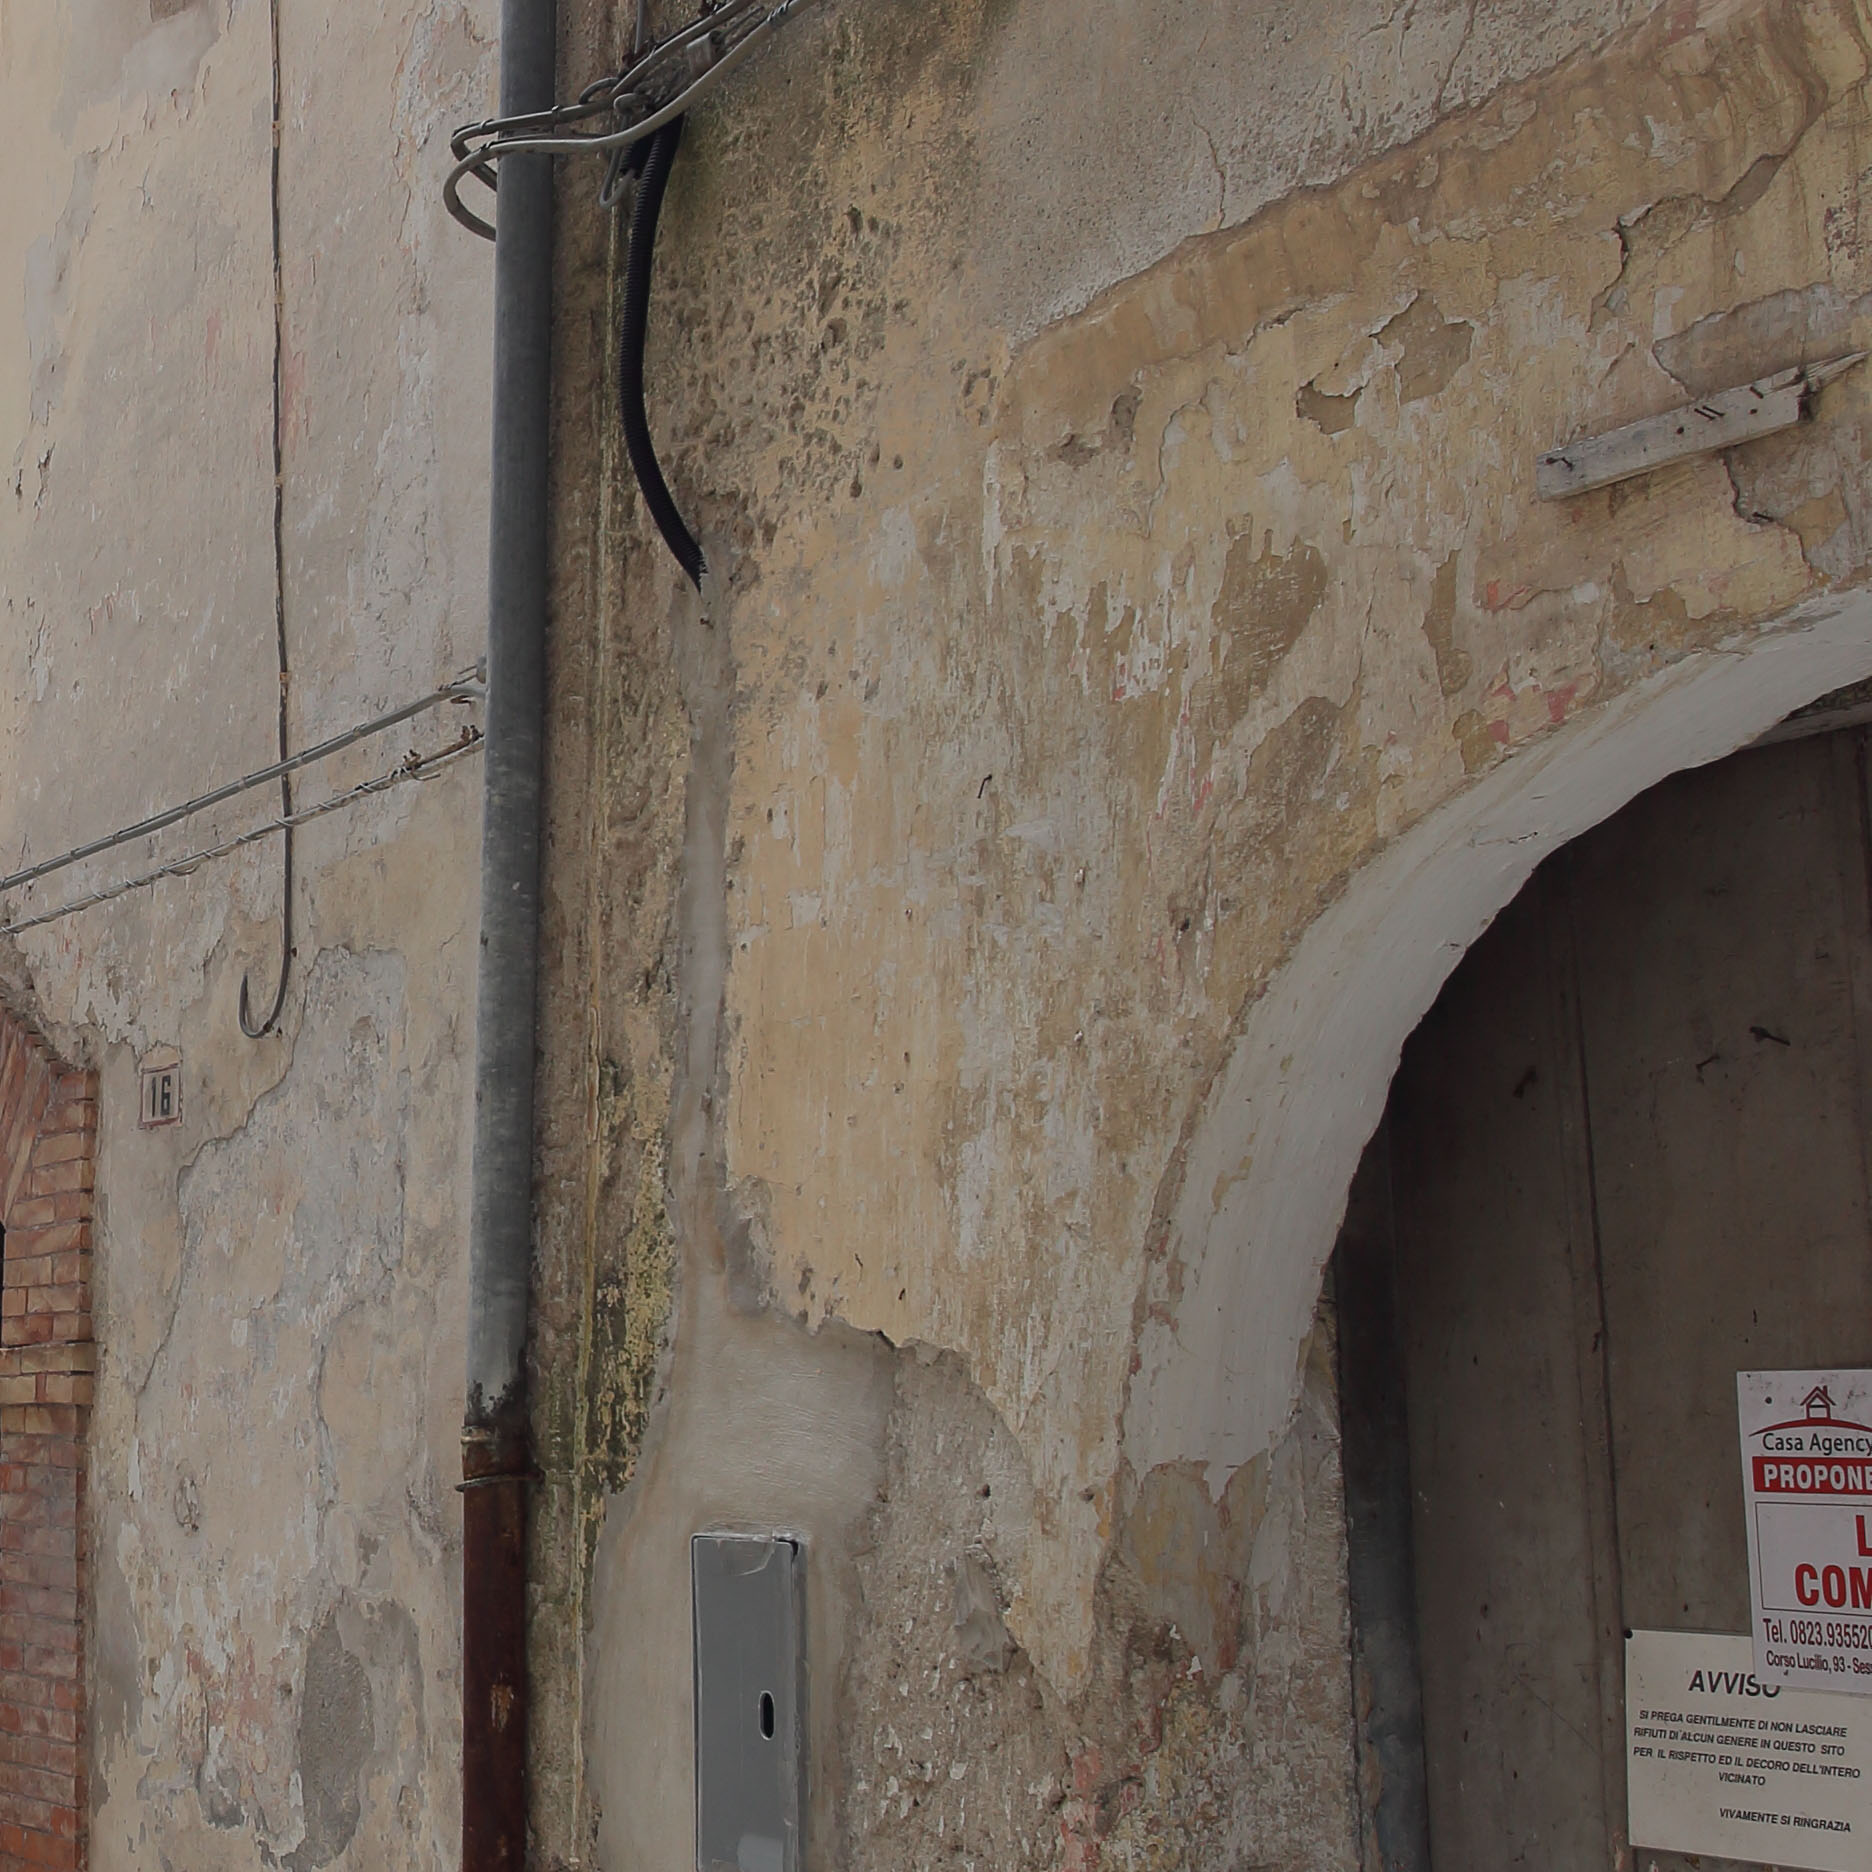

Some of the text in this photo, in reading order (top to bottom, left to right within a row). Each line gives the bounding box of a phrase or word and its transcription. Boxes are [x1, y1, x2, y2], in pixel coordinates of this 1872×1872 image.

[151, 1074, 171, 1117] 16
[1763, 1432, 1872, 1456] Casa Agency
[1762, 1617, 1787, 1643] Tel.
[1766, 1650, 1795, 1668] Corso
[1833, 1655, 1845, 1672] 93
[1639, 1710, 1848, 1737] SI PREGA GENTILMENTE DI NON LASCIARE
[1634, 1727, 1845, 1756] RIFIUTI DI ALCUN GENERE IN QUESTO SITO
[1633, 1746, 1861, 1779] PER IL RISPETTO ED IL DECORO DELL'INTERO
[1718, 1772, 1766, 1786] VICINATO
[1719, 1808, 1851, 1833] VIVAMENTE SI RINGRAZIA
